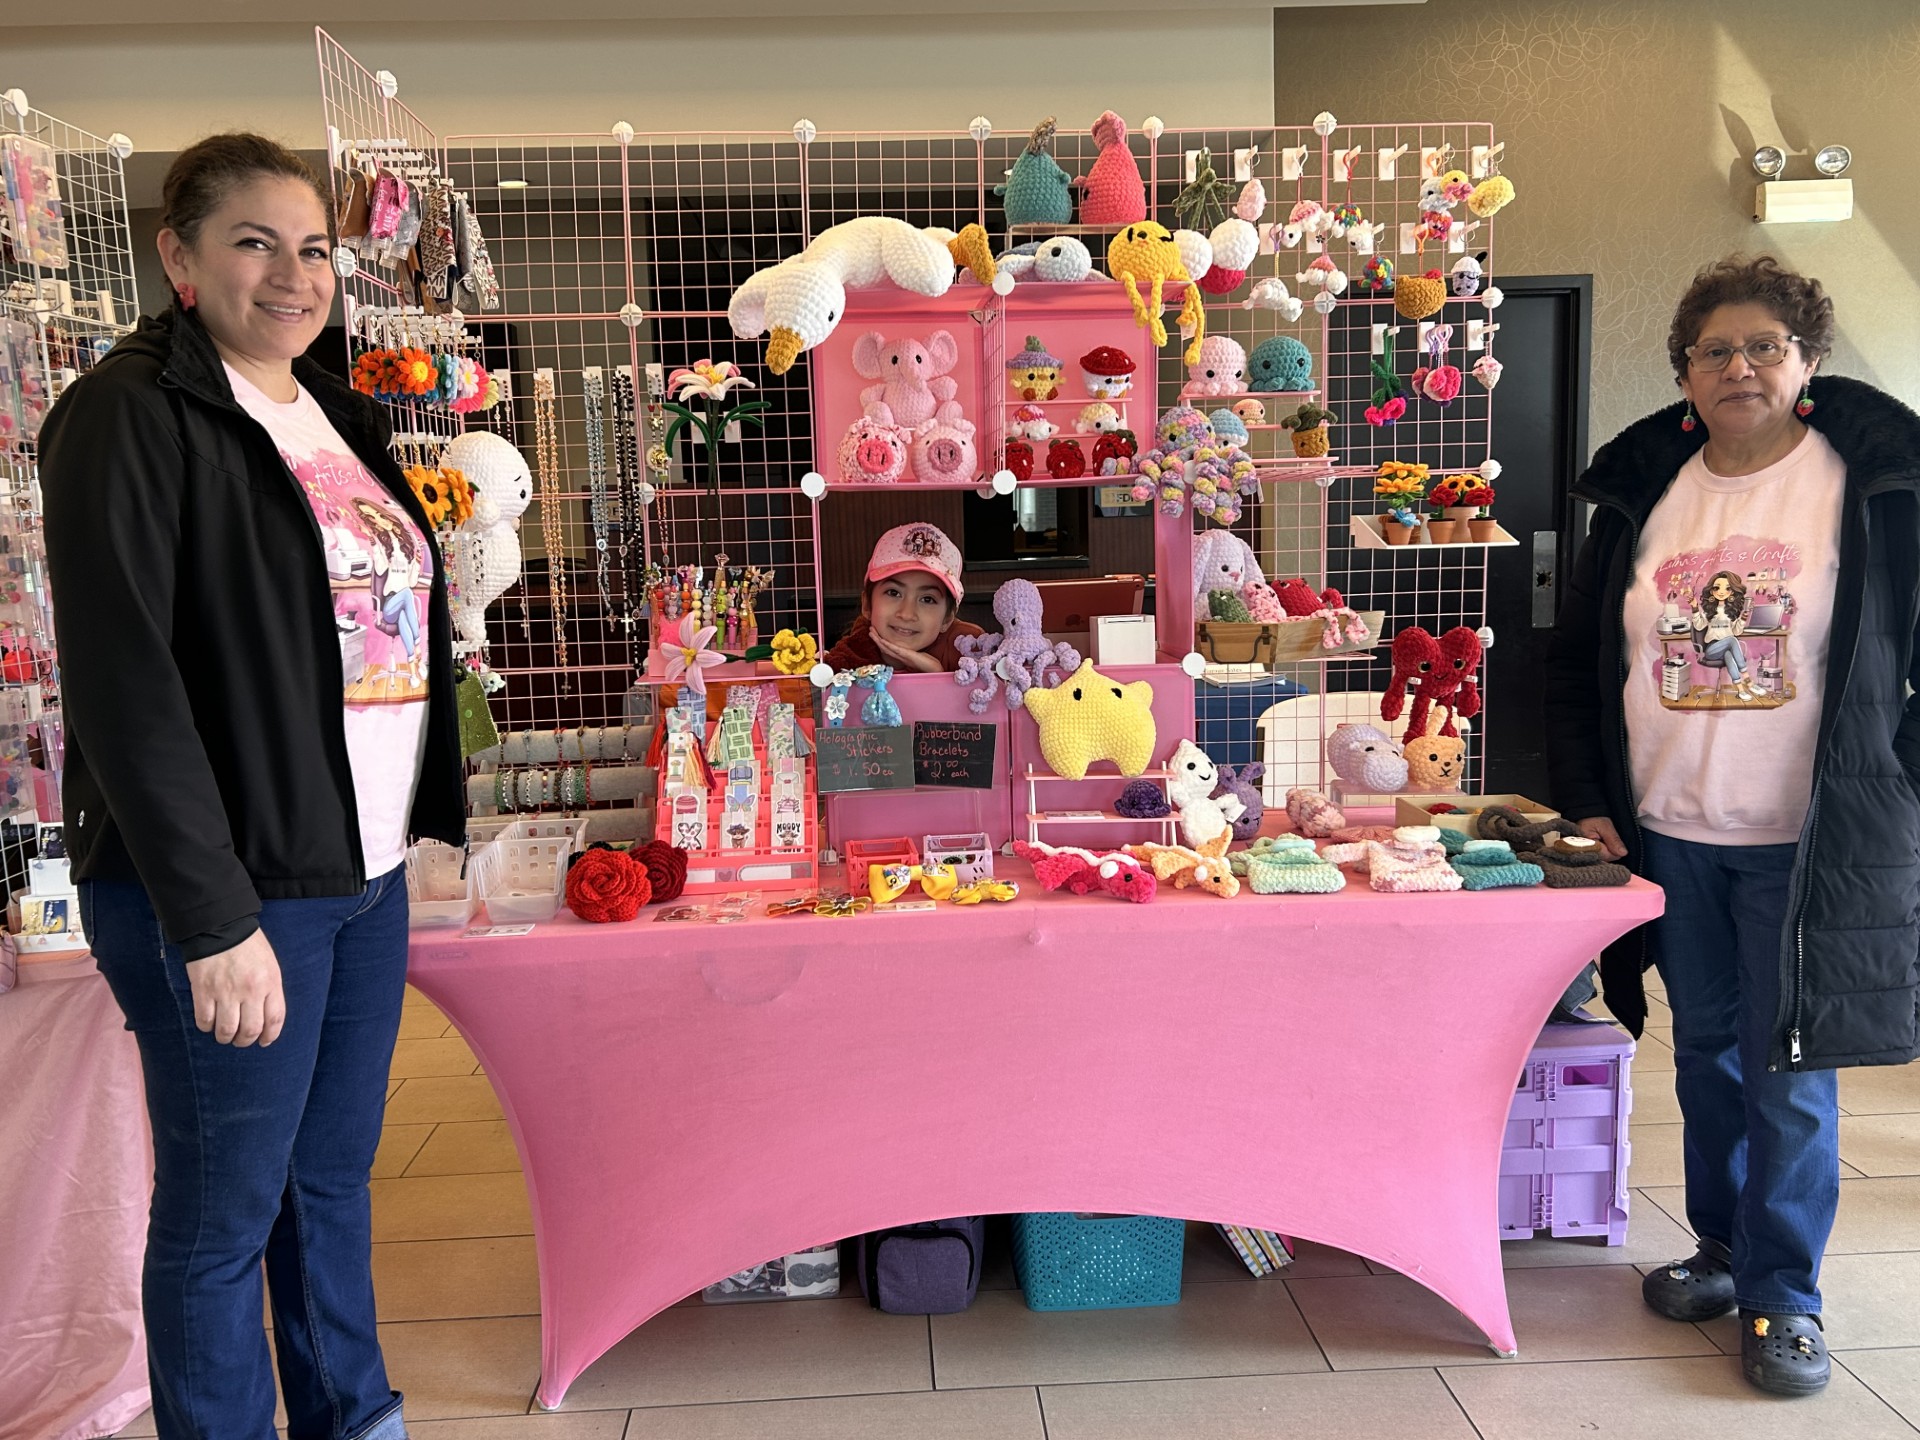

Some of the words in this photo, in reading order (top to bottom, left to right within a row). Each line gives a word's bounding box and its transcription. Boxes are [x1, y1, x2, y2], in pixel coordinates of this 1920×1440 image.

[312, 461, 348, 488] Arts
[1700, 545, 1732, 569] Arts
[1738, 551, 1748, 561] &
[1752, 544, 1800, 563] Crafts
[915, 723, 982, 741] Rubberband
[819, 731, 878, 750] Holographic
[846, 743, 893, 757] Stickers
[919, 742, 969, 757] Bracelets
[882, 769, 894, 777] ea
[950, 769, 970, 778] each
[776, 822, 801, 834] MOODY
